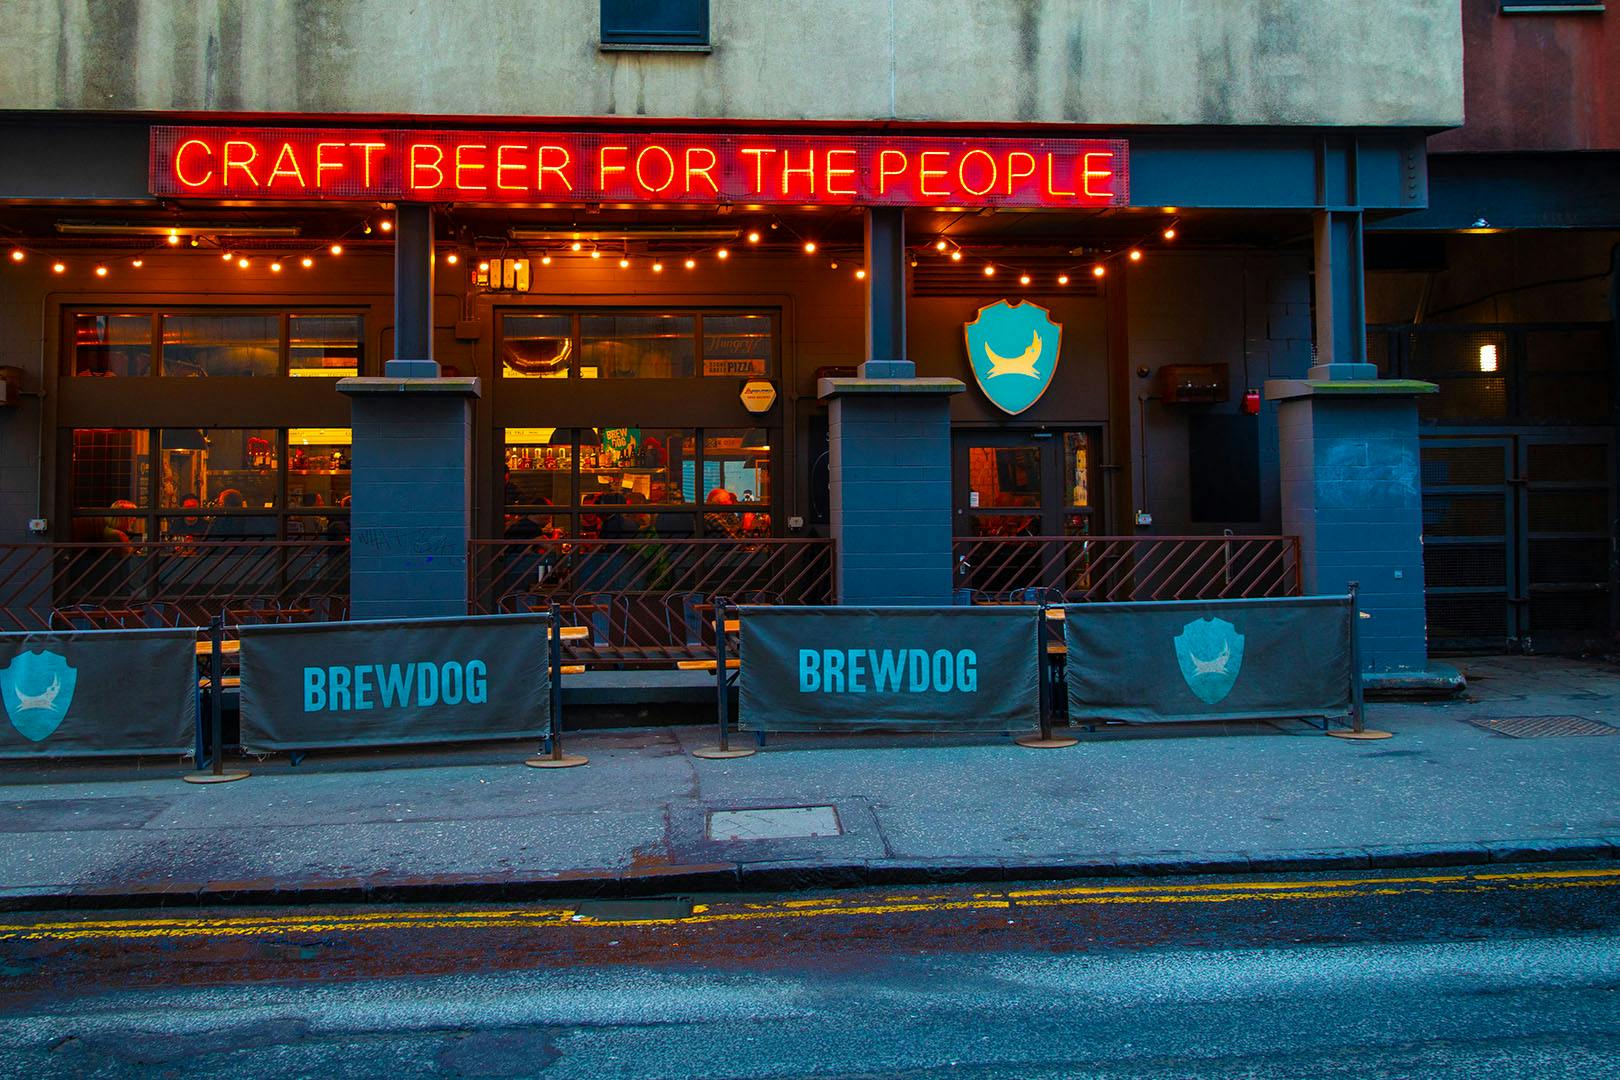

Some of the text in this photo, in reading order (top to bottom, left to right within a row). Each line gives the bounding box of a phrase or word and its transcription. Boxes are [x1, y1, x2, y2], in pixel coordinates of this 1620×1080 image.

[175, 139, 1114, 197] CRAFT BEER FOR THE PEOPLE
[727, 361, 754, 373] PIZZA
[606, 428, 627, 440] BREW
[303, 659, 488, 713] BREWDOG
[798, 648, 978, 693] BREWDOG
